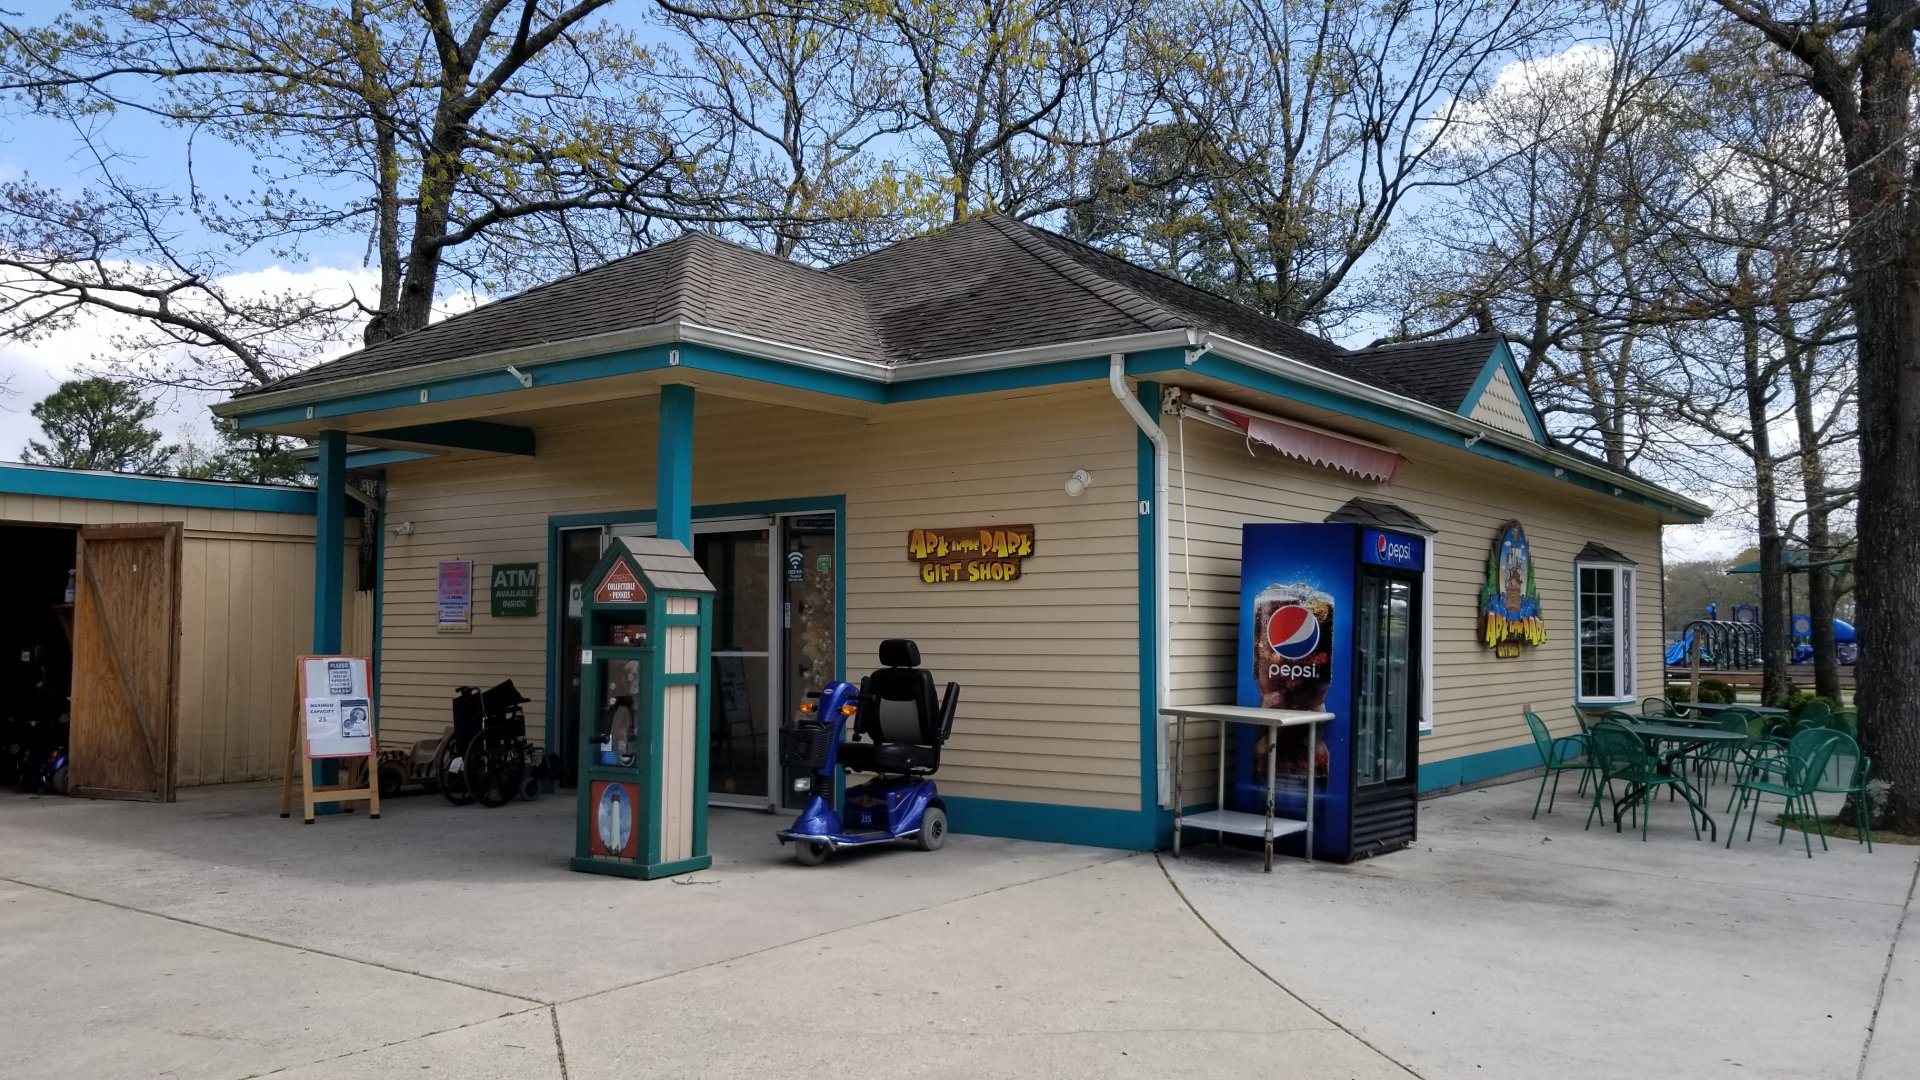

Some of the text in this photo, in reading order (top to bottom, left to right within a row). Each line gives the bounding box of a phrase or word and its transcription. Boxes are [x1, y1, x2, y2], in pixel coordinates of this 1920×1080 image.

[980, 530, 1031, 557] PARK
[1388, 543, 1411, 562] pepsi
[493, 570, 536, 587] ATM
[923, 561, 1016, 583] GIFT SHOP
[496, 590, 535, 598] AVAILABLE
[607, 582, 636, 591] COLLECTIBLE
[612, 591, 631, 599] PENNIES
[503, 600, 527, 608] INSIDE
[1268, 663, 1316, 680] pepsi
